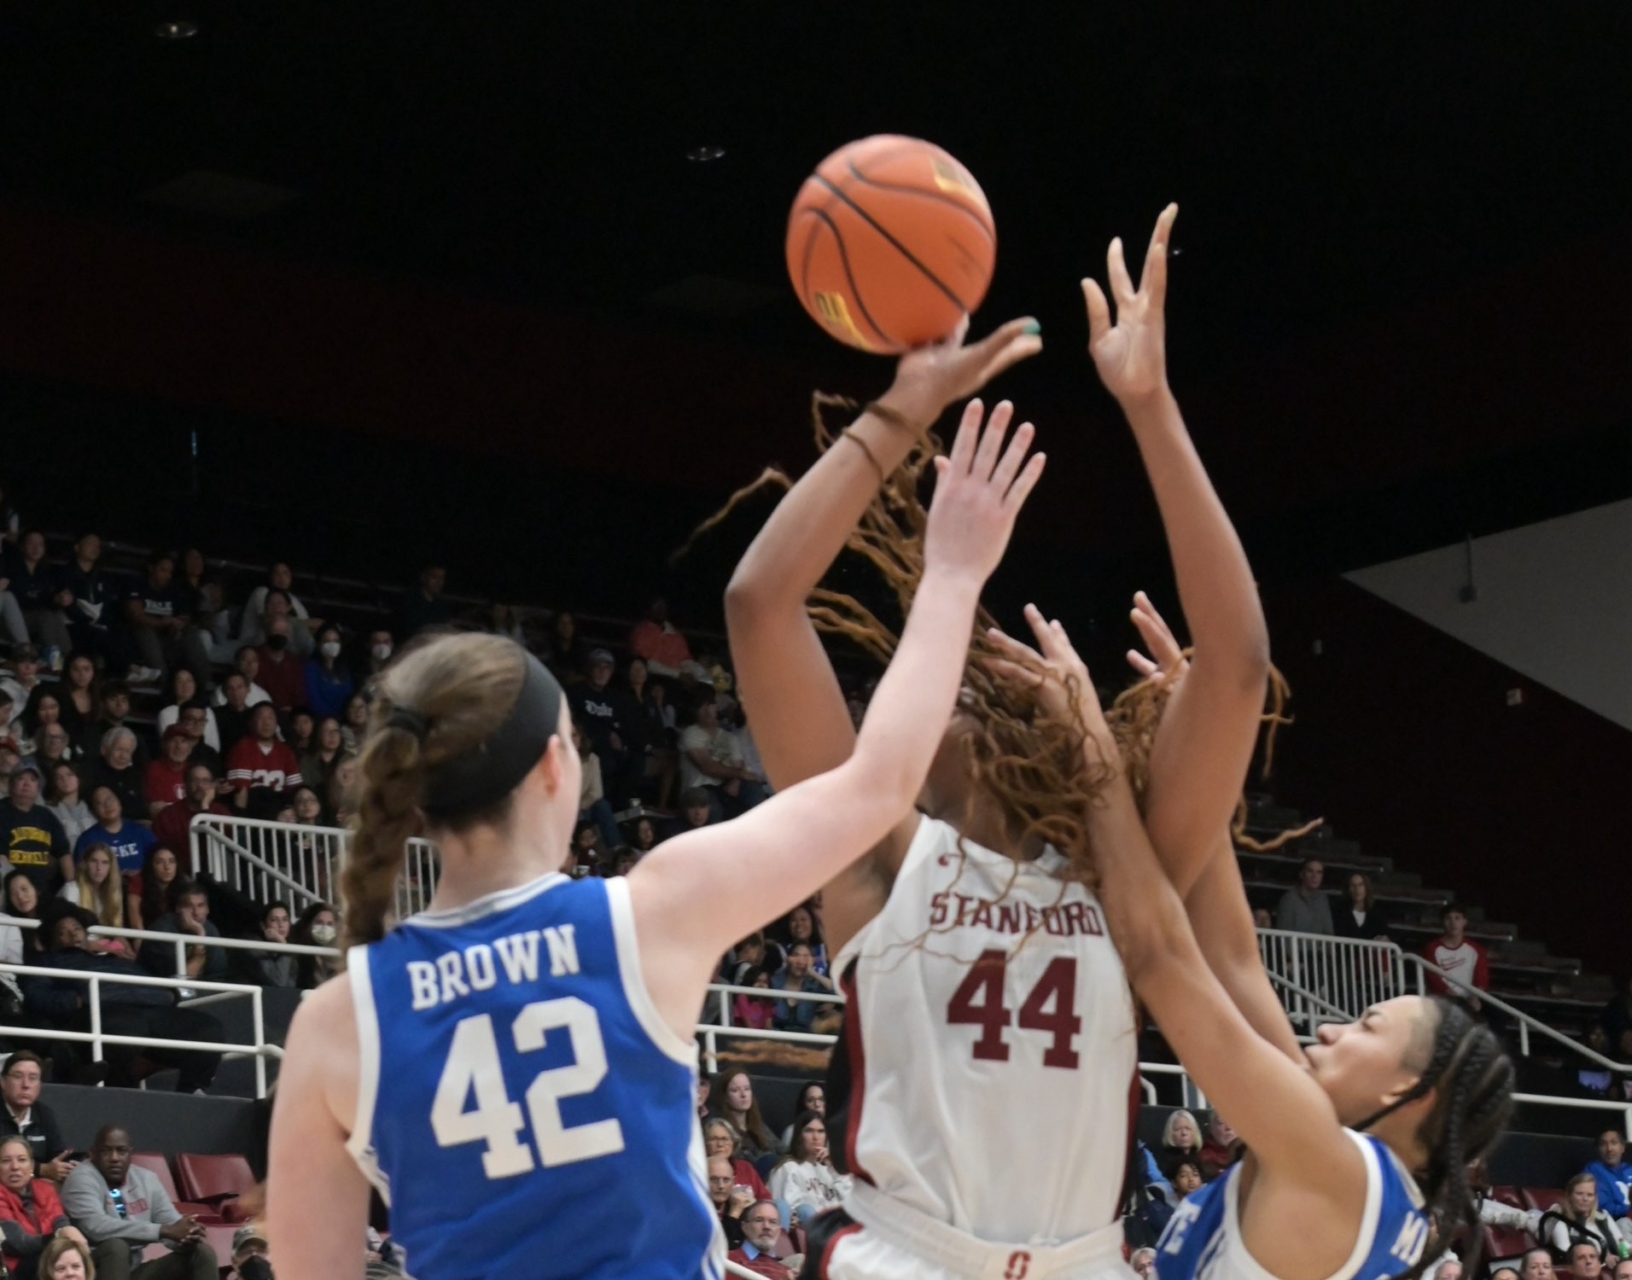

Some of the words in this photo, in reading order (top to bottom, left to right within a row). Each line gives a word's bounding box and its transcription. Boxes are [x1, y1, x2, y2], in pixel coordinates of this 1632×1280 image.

[930, 891, 1104, 937] STANFORD
[406, 924, 580, 1011] BROWN
[947, 948, 1081, 1070] 44
[430, 996, 625, 1180] 42
